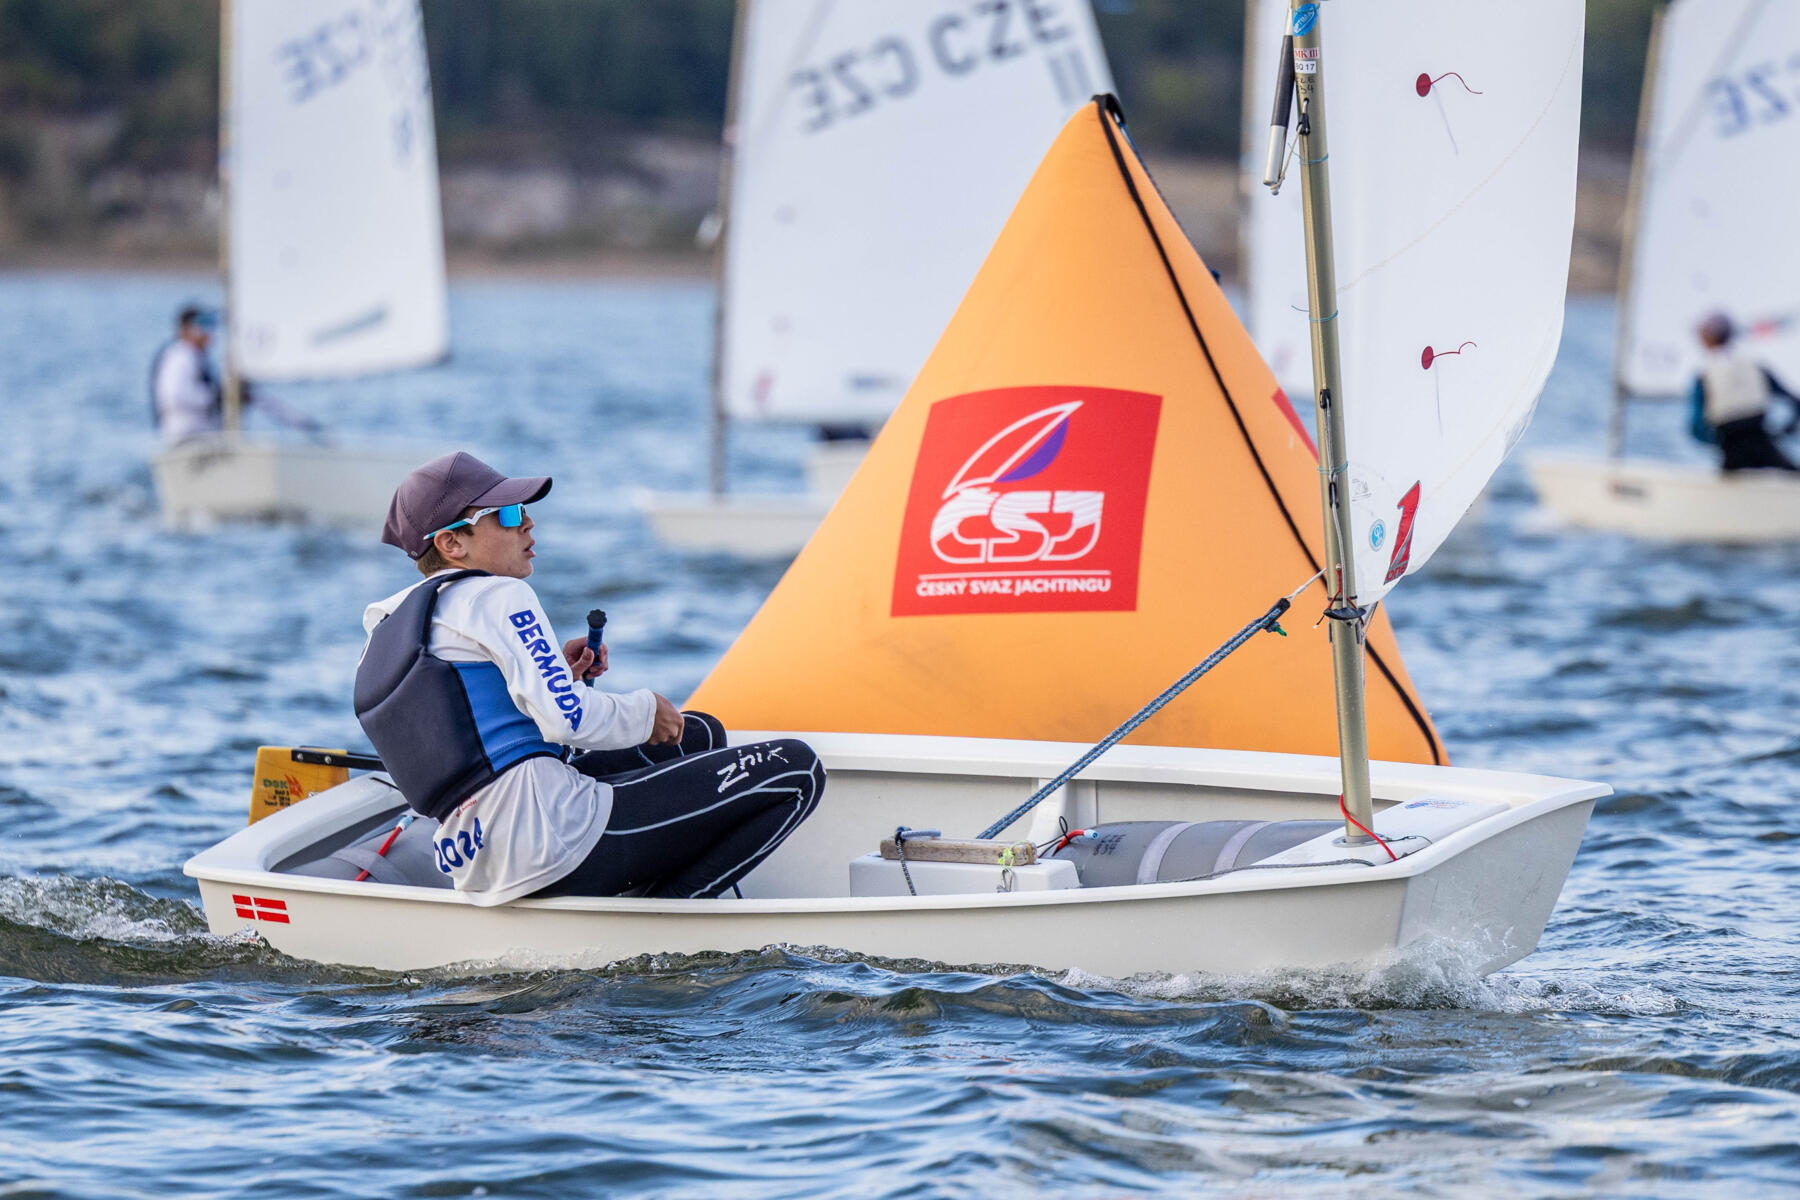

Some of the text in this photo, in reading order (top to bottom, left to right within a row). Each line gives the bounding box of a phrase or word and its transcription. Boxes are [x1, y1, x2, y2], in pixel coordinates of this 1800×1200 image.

[928, 0, 1073, 77] CZE
[1305, 62, 1315, 71] 17
[916, 577, 1111, 597] ČESKÝ SVAZ JACHTINGU
[509, 609, 583, 732] BERMUDA
